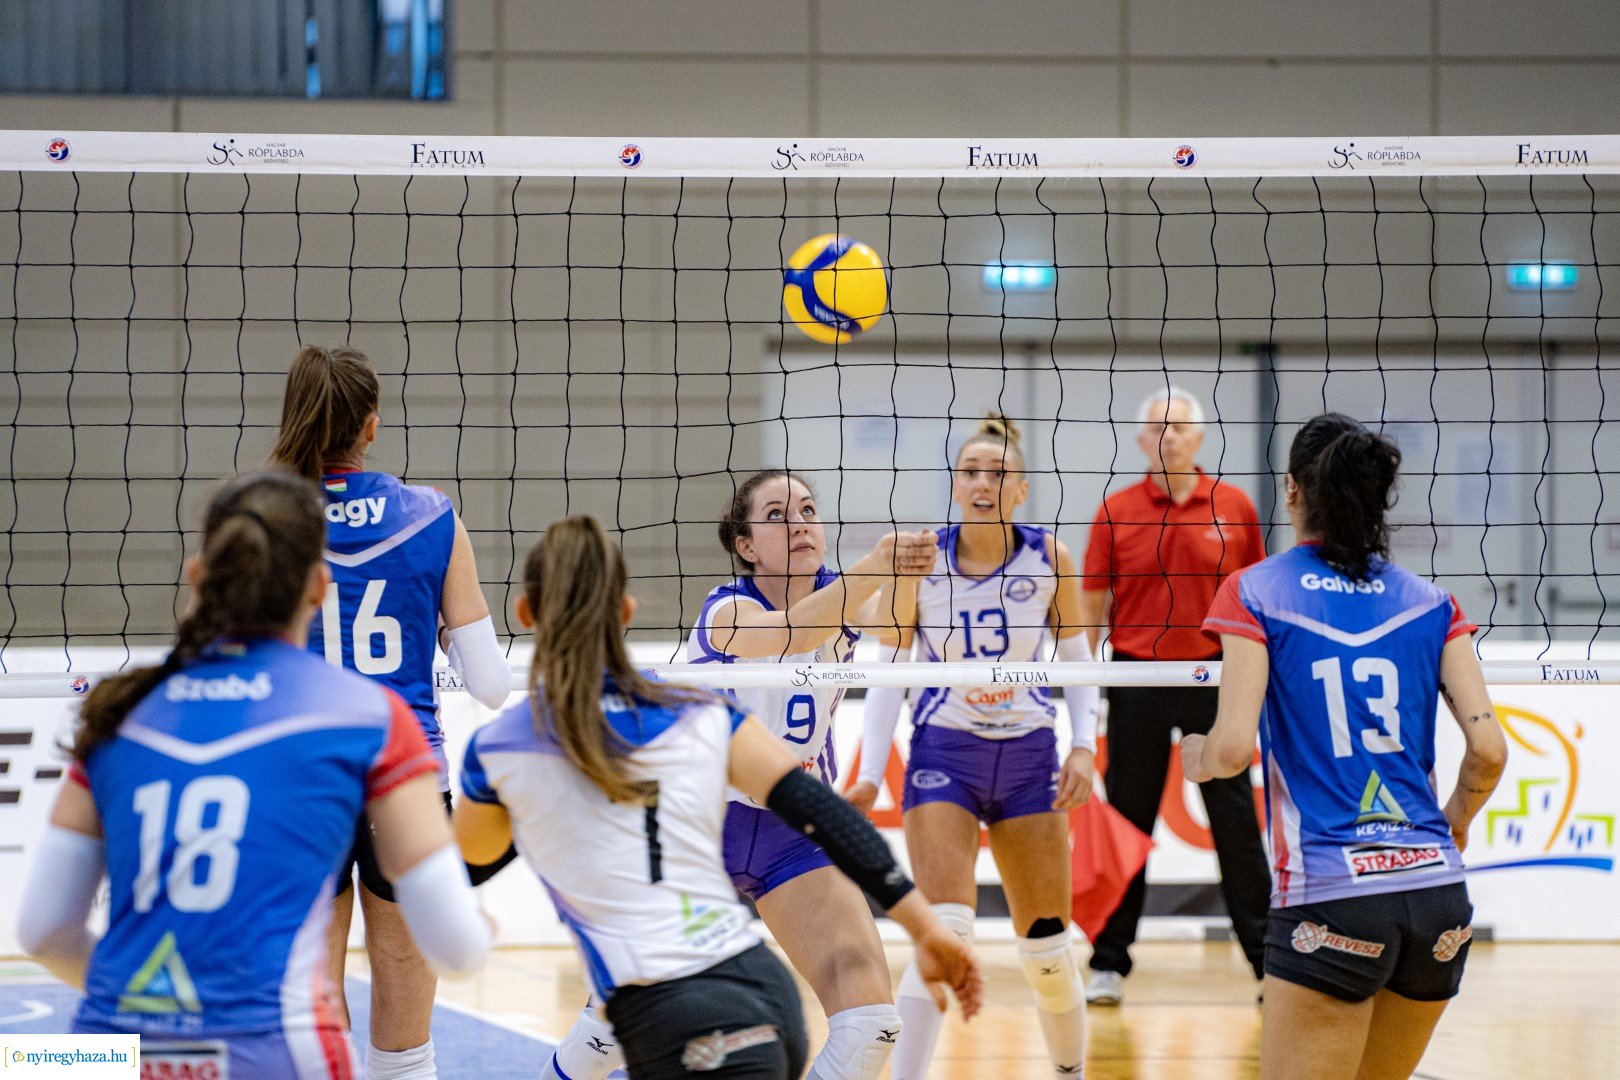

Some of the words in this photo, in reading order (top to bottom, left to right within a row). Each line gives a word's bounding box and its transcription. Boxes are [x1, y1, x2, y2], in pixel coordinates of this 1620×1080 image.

[248, 147, 304, 158] RÖPLABDA
[410, 142, 485, 164] FATUM
[810, 151, 865, 161] RÖPLABDA
[966, 145, 1039, 167] FATUM
[1367, 150, 1421, 161] RÖPLABDA
[1516, 142, 1589, 164] FATUM
[324, 497, 386, 528] agy
[322, 579, 403, 675] 16
[959, 608, 1009, 659] 13
[822, 671, 866, 680] RÖPLABDA
[991, 666, 1049, 683] FATUM
[1540, 664, 1600, 681] FATUM
[1311, 656, 1405, 758] 13
[782, 694, 816, 745] 9
[133, 774, 251, 914] 18
[1352, 848, 1439, 873] STRABAG
